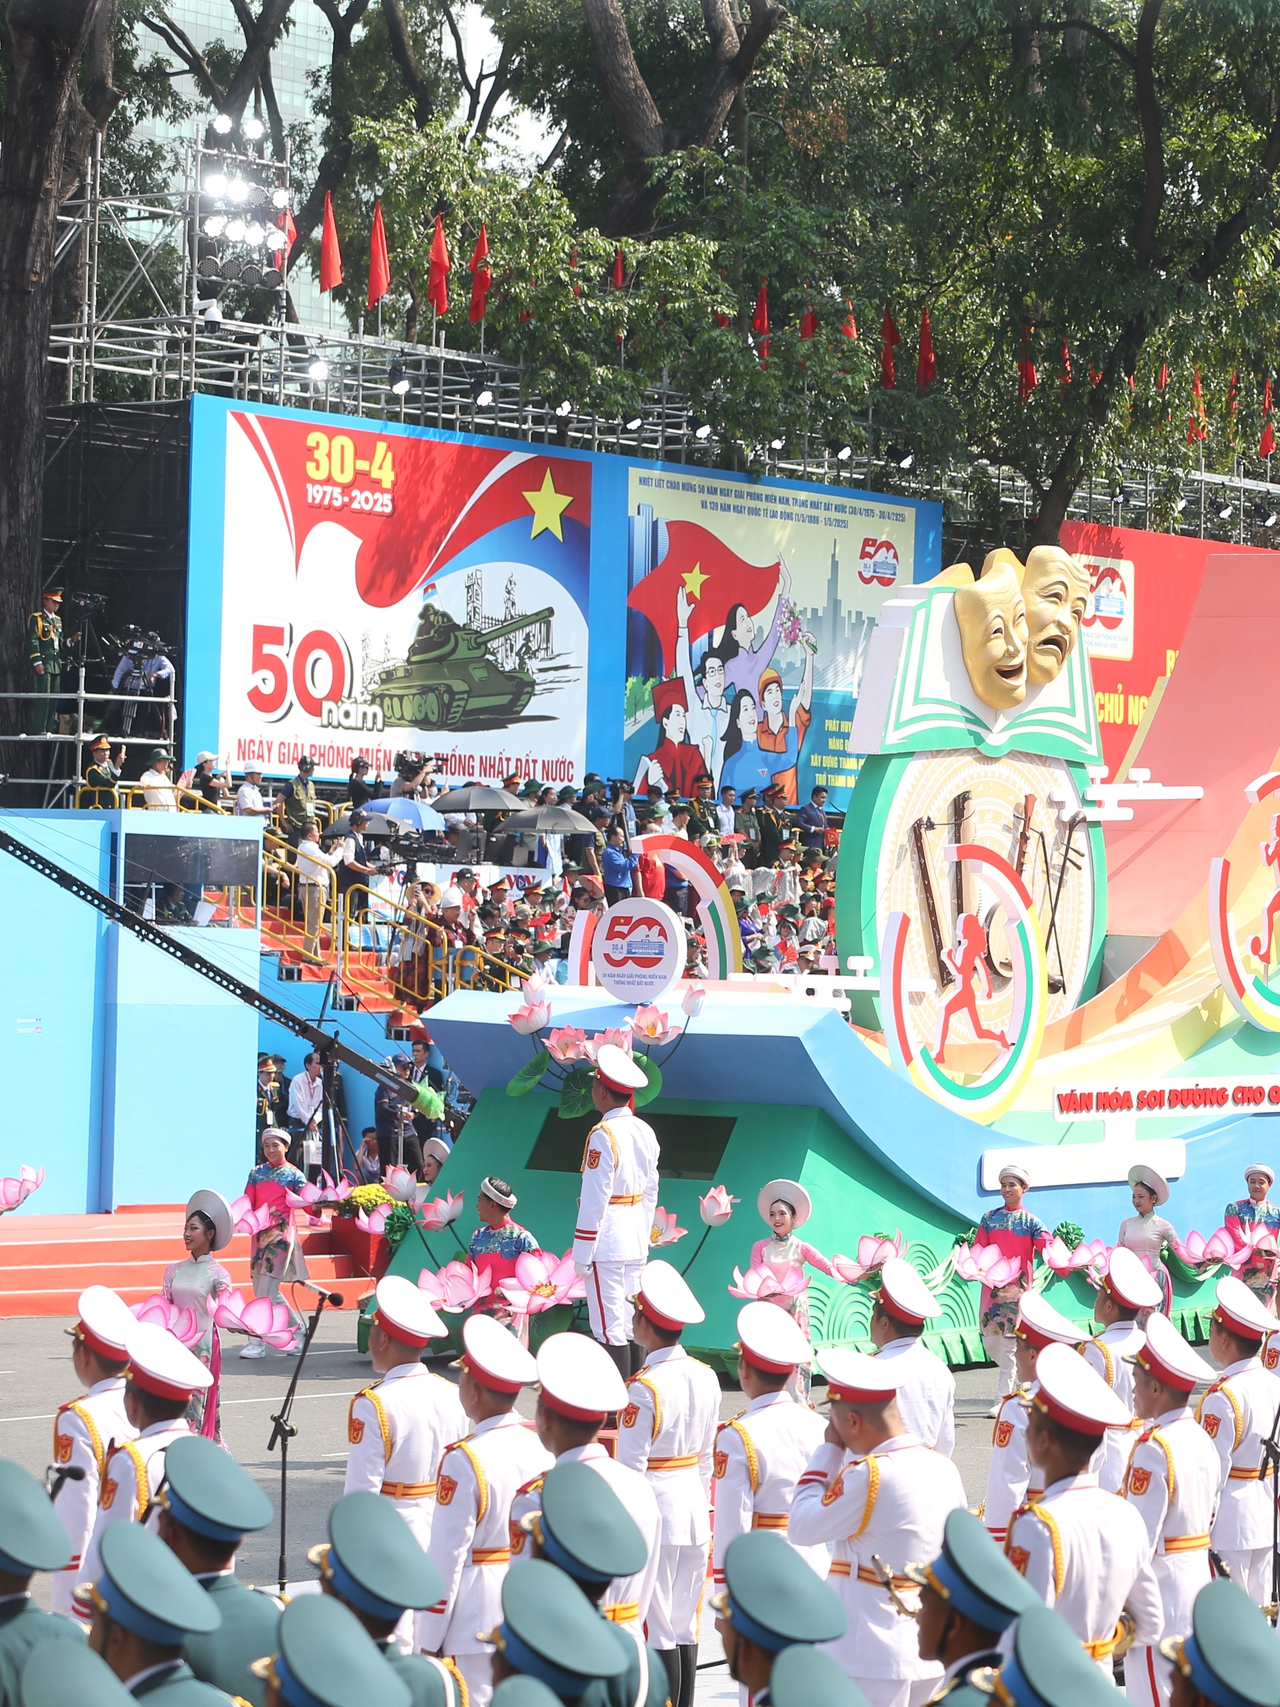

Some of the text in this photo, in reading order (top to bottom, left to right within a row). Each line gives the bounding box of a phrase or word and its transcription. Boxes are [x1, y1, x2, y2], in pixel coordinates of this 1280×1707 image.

[305, 431, 395, 489] 30-4
[698, 484, 705, 494] 50
[707, 485, 718, 496] NĂM
[720, 487, 733, 498] NGÀY
[701, 499, 708, 509] VÀ
[710, 501, 718, 511] 139
[720, 502, 731, 513] NĂM
[733, 504, 746, 515] NGÀY
[770, 509, 778, 519] LAO
[246, 623, 385, 731] 50 năm
[1095, 684, 1124, 725] CHỦ
[237, 734, 273, 763] NGÀY
[479, 748, 511, 778] NHẤT
[542, 755, 574, 783] NƯỚC
[1096, 1087, 1134, 1111] HÓA
[1136, 1090, 1165, 1109] SOI
[1168, 1083, 1229, 1108] ĐƯỜNG
[1233, 1085, 1265, 1105] CHO
